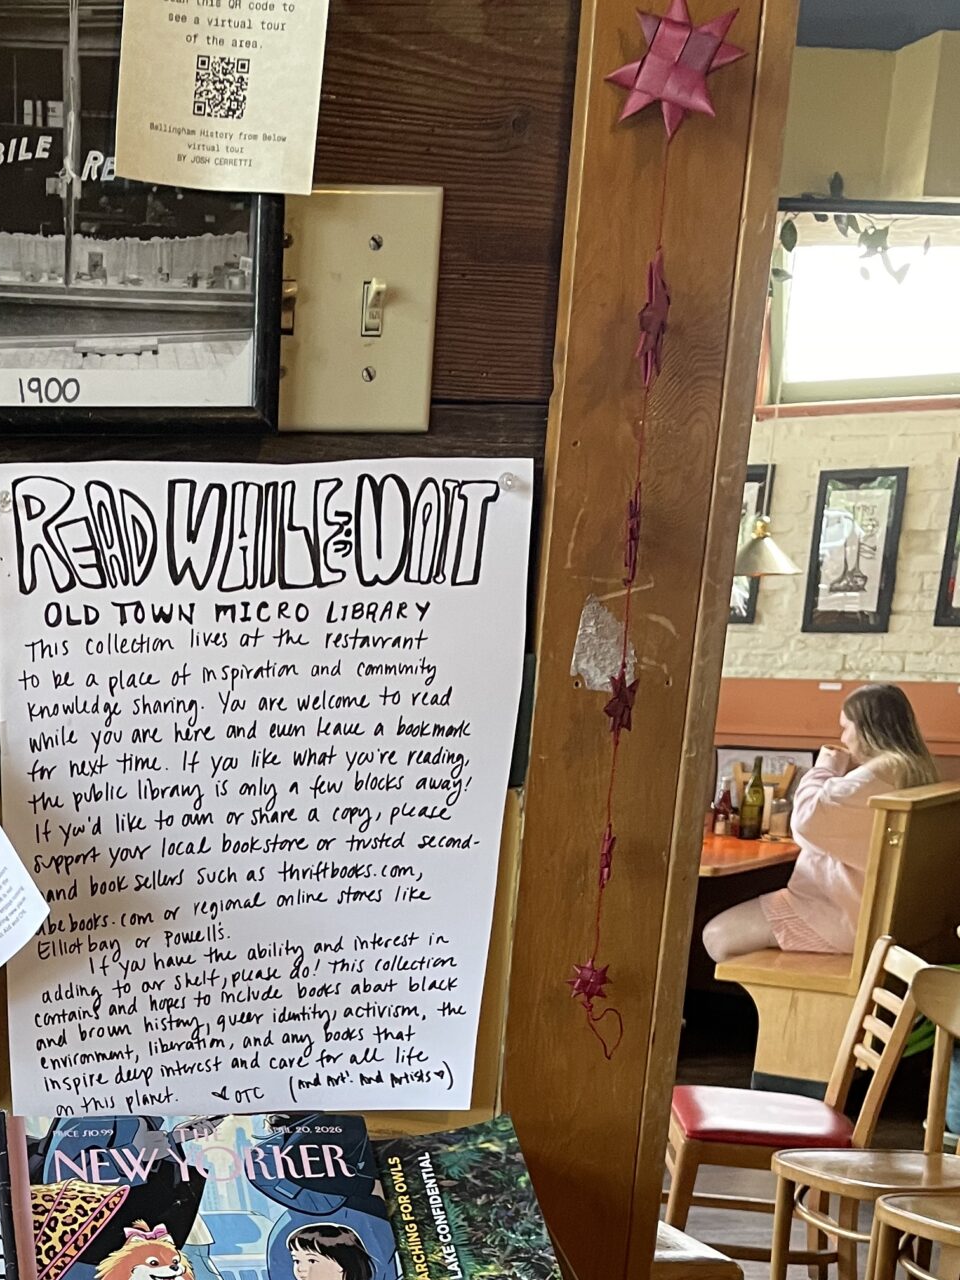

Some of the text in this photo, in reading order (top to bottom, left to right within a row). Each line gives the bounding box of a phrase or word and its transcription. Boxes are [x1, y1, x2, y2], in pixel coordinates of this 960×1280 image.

[169, 13, 286, 31] see a virtual tour
[200, 125, 233, 140] History
[239, 130, 258, 141] from
[262, 132, 287, 142] Below
[177, 154, 187, 163] BY
[191, 155, 210, 165] JOSH
[188, 142, 245, 154] virtual tour
[18, 377, 81, 403] 1900
[12, 476, 157, 595] READ
[167, 478, 346, 592] WHILE
[354, 473, 500, 587] WAIT
[45, 600, 431, 627] OLD TOWN MICRO LIBRARY
[25, 627, 429, 663] This collection lives at the restaurant
[18, 656, 437, 697] to be a place of inspiration and community
[54, 1144, 356, 1183] NEW YORKER
